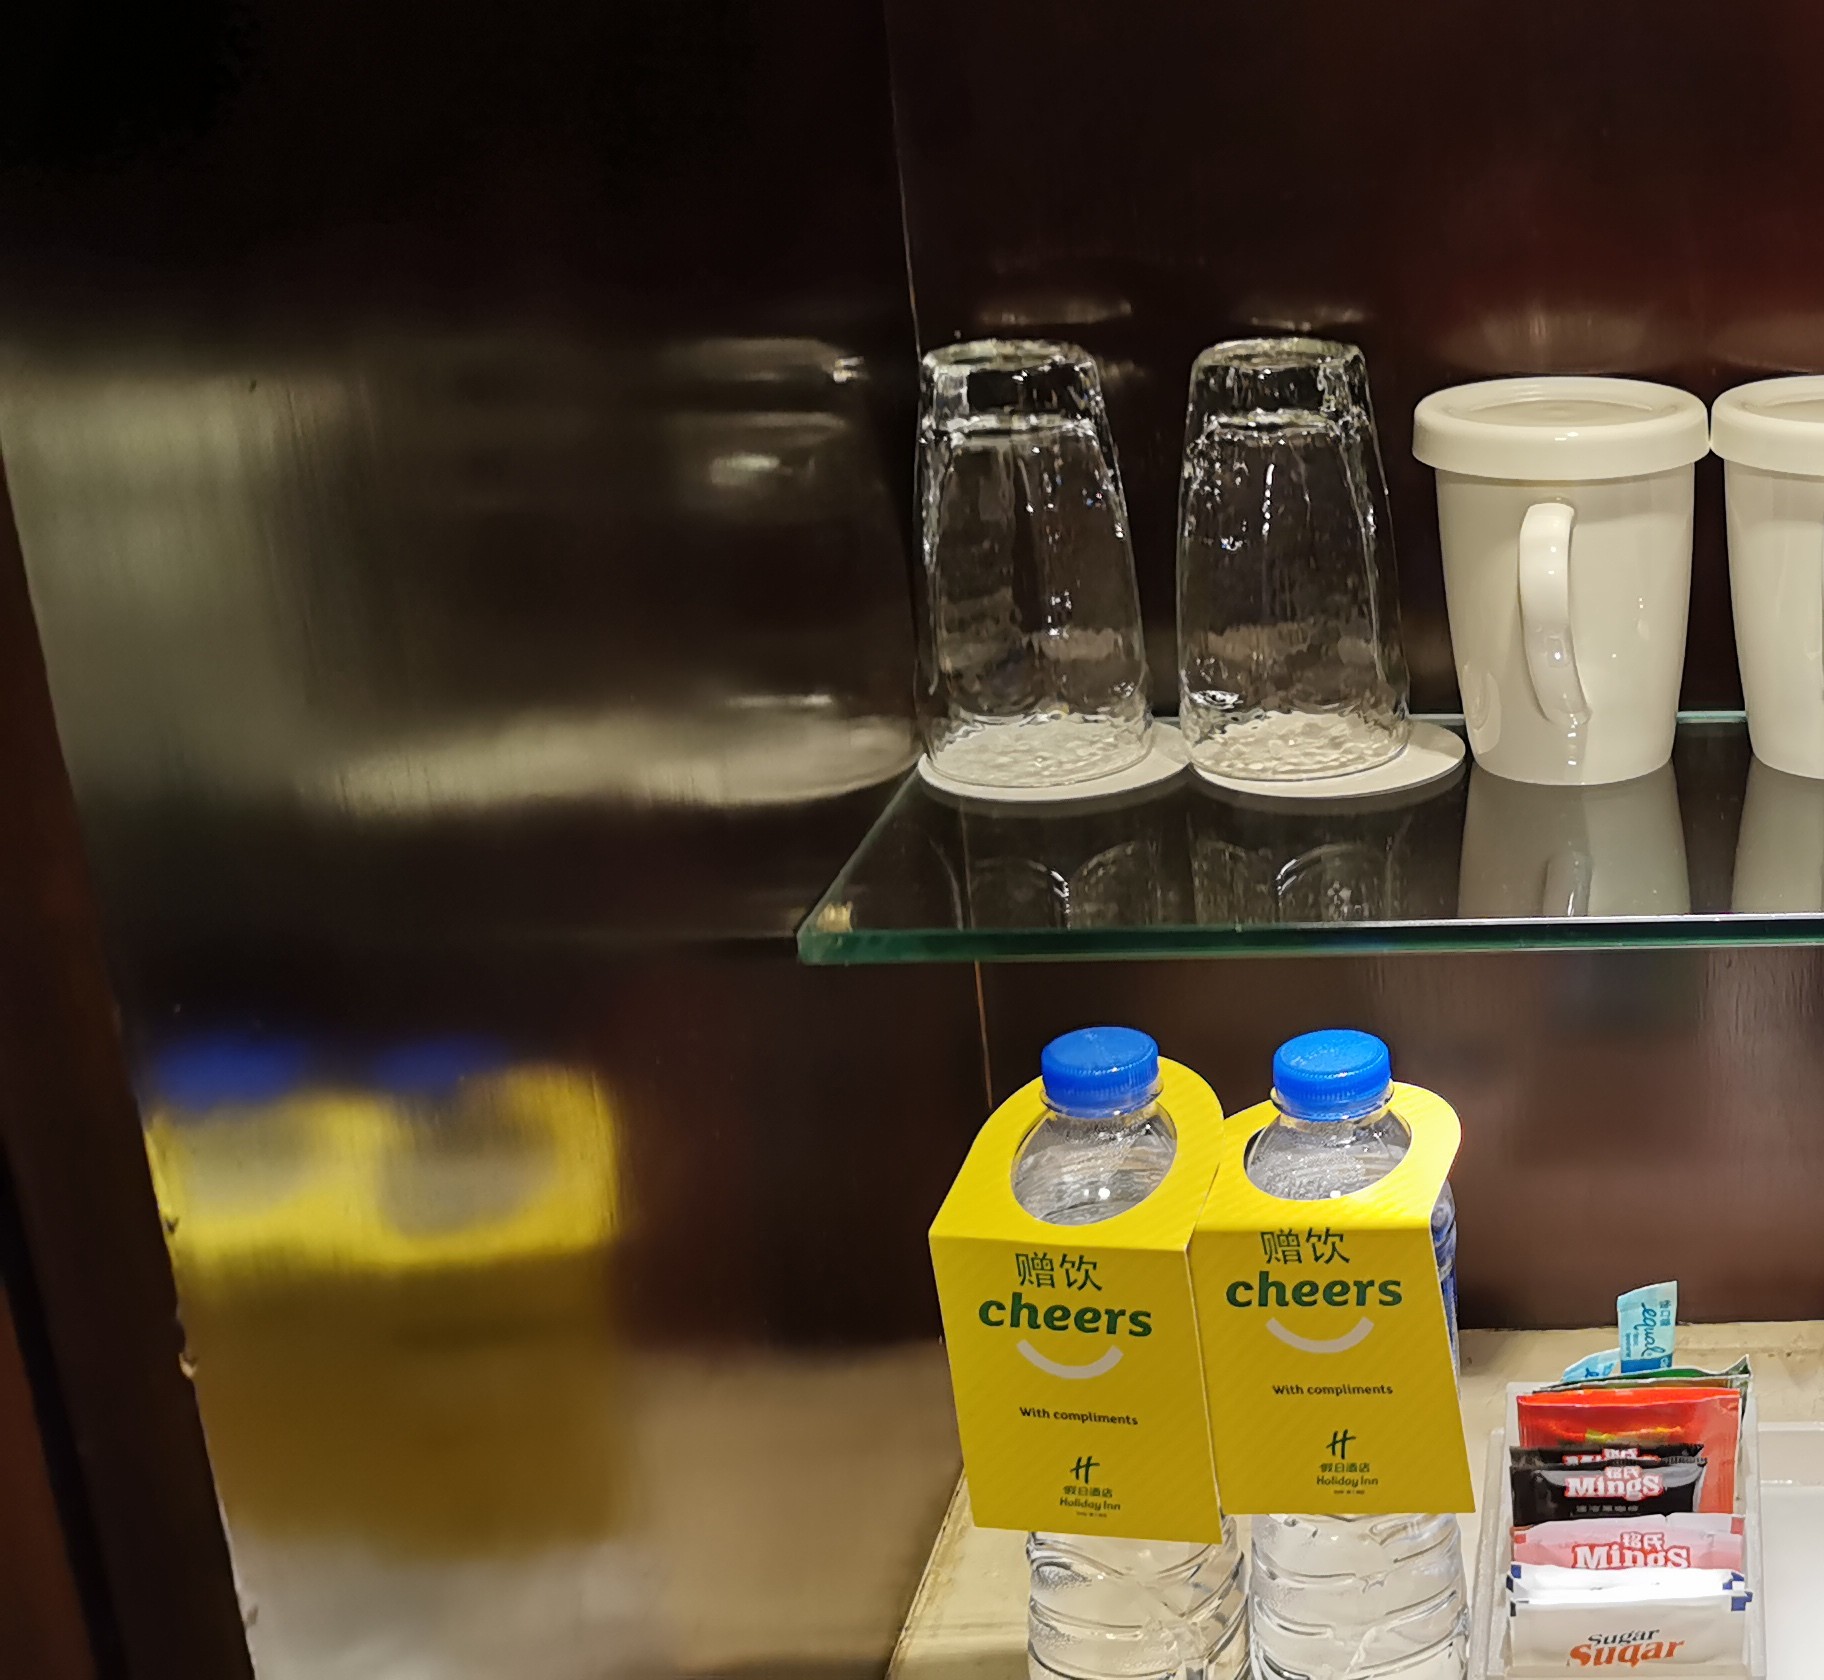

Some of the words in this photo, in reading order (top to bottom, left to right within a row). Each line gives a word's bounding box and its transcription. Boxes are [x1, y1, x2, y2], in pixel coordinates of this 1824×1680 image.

[1261, 1227, 1350, 1264] 赠饮
[1015, 1252, 1103, 1291] 赠饮
[1226, 1271, 1403, 1307] cheers
[979, 1292, 1153, 1337] cheers
[1272, 1384, 1304, 1395] With
[1307, 1384, 1393, 1396] compliments
[1019, 1407, 1050, 1419] With
[1053, 1410, 1138, 1425] compliments
[1316, 1475, 1359, 1488] Holiday
[1360, 1476, 1379, 1485] Inn
[1060, 1498, 1101, 1511] Holiday
[1103, 1501, 1121, 1511] Inn
